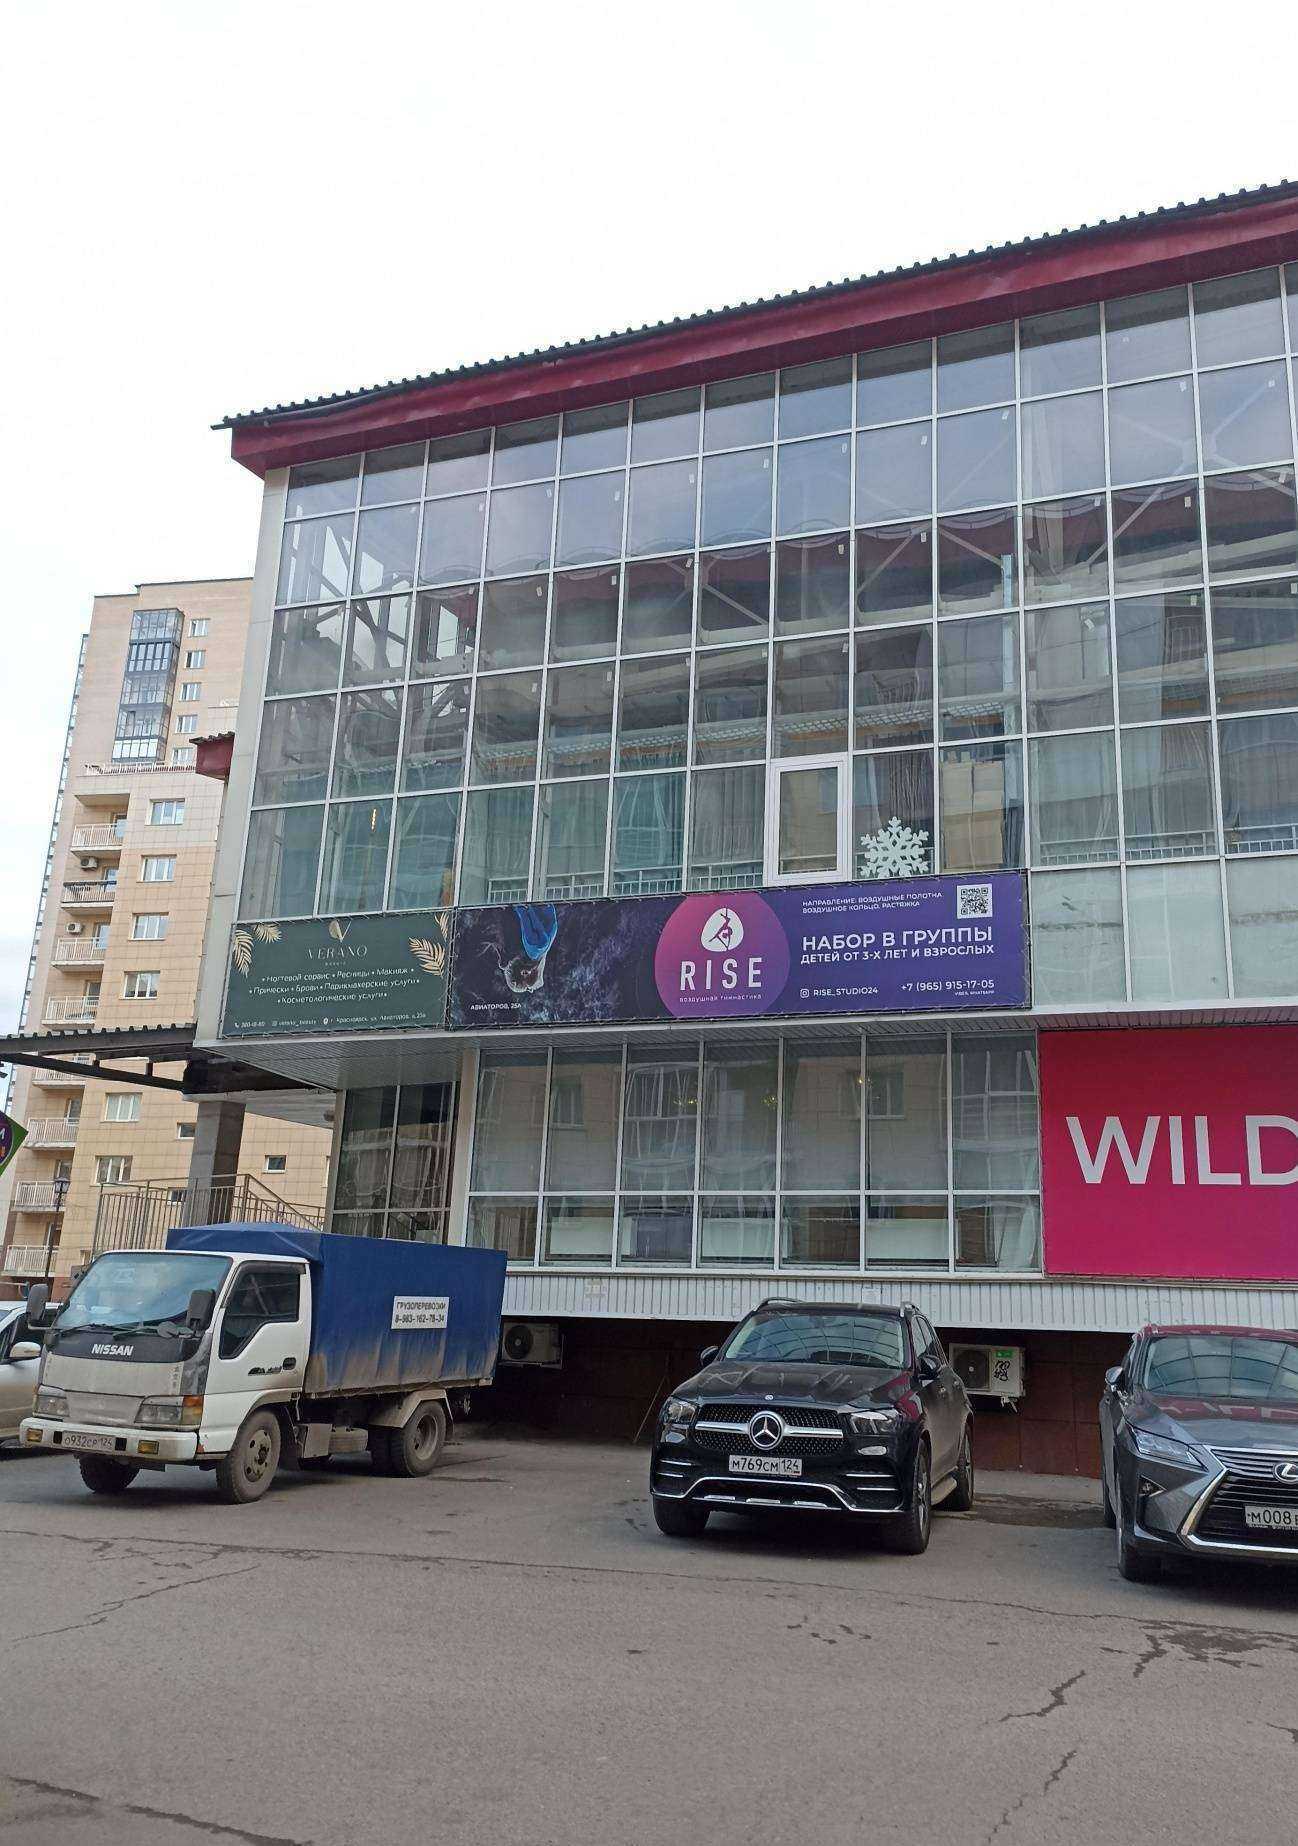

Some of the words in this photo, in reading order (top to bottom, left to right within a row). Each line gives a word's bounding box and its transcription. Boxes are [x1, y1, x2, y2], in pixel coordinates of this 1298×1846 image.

[858, 894, 905, 903] ВОЗДУШНЫЕ
[802, 905, 848, 914] ВОЗДУШНОЕ
[802, 933, 876, 951] НАБОР
[882, 931, 896, 947] В
[902, 926, 993, 946] ГРУППЫ
[306, 945, 368, 960] VERANO
[800, 951, 840, 965] ДЕТЕЙ
[843, 951, 862, 961] ОТ
[862, 950, 881, 961] 3-Х
[884, 949, 908, 960] ЛЕТ
[911, 948, 920, 958] И
[924, 944, 995, 957] ВЗРОСЛЫХ
[266, 973, 302, 982] Ногтевой
[303, 973, 330, 983] сервис
[336, 970, 370, 979] Ресницы
[376, 968, 408, 977] Макияж
[680, 957, 763, 991] RISE
[253, 986, 290, 995] Прически
[295, 984, 319, 993] Брови
[324, 980, 388, 991] Парикмахерские
[390, 978, 417, 988] услуги
[901, 983, 913, 991] +7
[916, 981, 942, 992] (965)
[945, 979, 995, 990] 915-17-05
[281, 994, 356, 1004] Косметологические
[358, 991, 384, 1001] услуги
[1065, 1115, 1298, 1186] WILD
[396, 1301, 446, 1310] ГРУЗОПЕРЕВОЗКИ
[91, 1343, 134, 1356] NISSAN
[1251, 1509, 1298, 1526] М008
